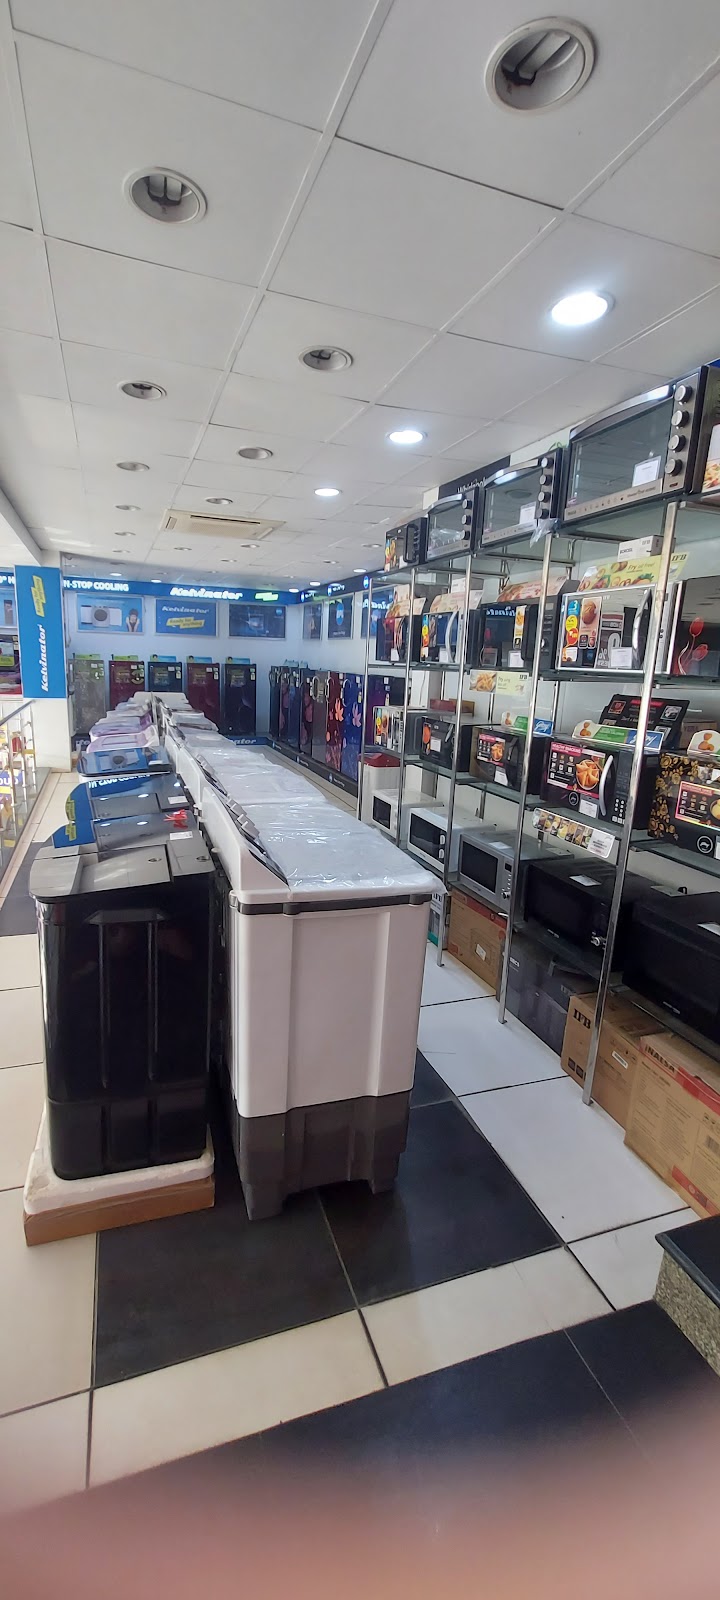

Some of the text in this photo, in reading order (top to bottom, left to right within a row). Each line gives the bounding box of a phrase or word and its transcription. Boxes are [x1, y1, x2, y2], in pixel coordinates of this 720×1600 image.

[671, 554, 687, 562] IFB
[93, 581, 130, 592] COOLING
[170, 587, 243, 600] Kelvinator
[161, 605, 209, 614] Kelvinator
[38, 624, 49, 692] Kelvinator
[573, 1008, 592, 1029] IFB
